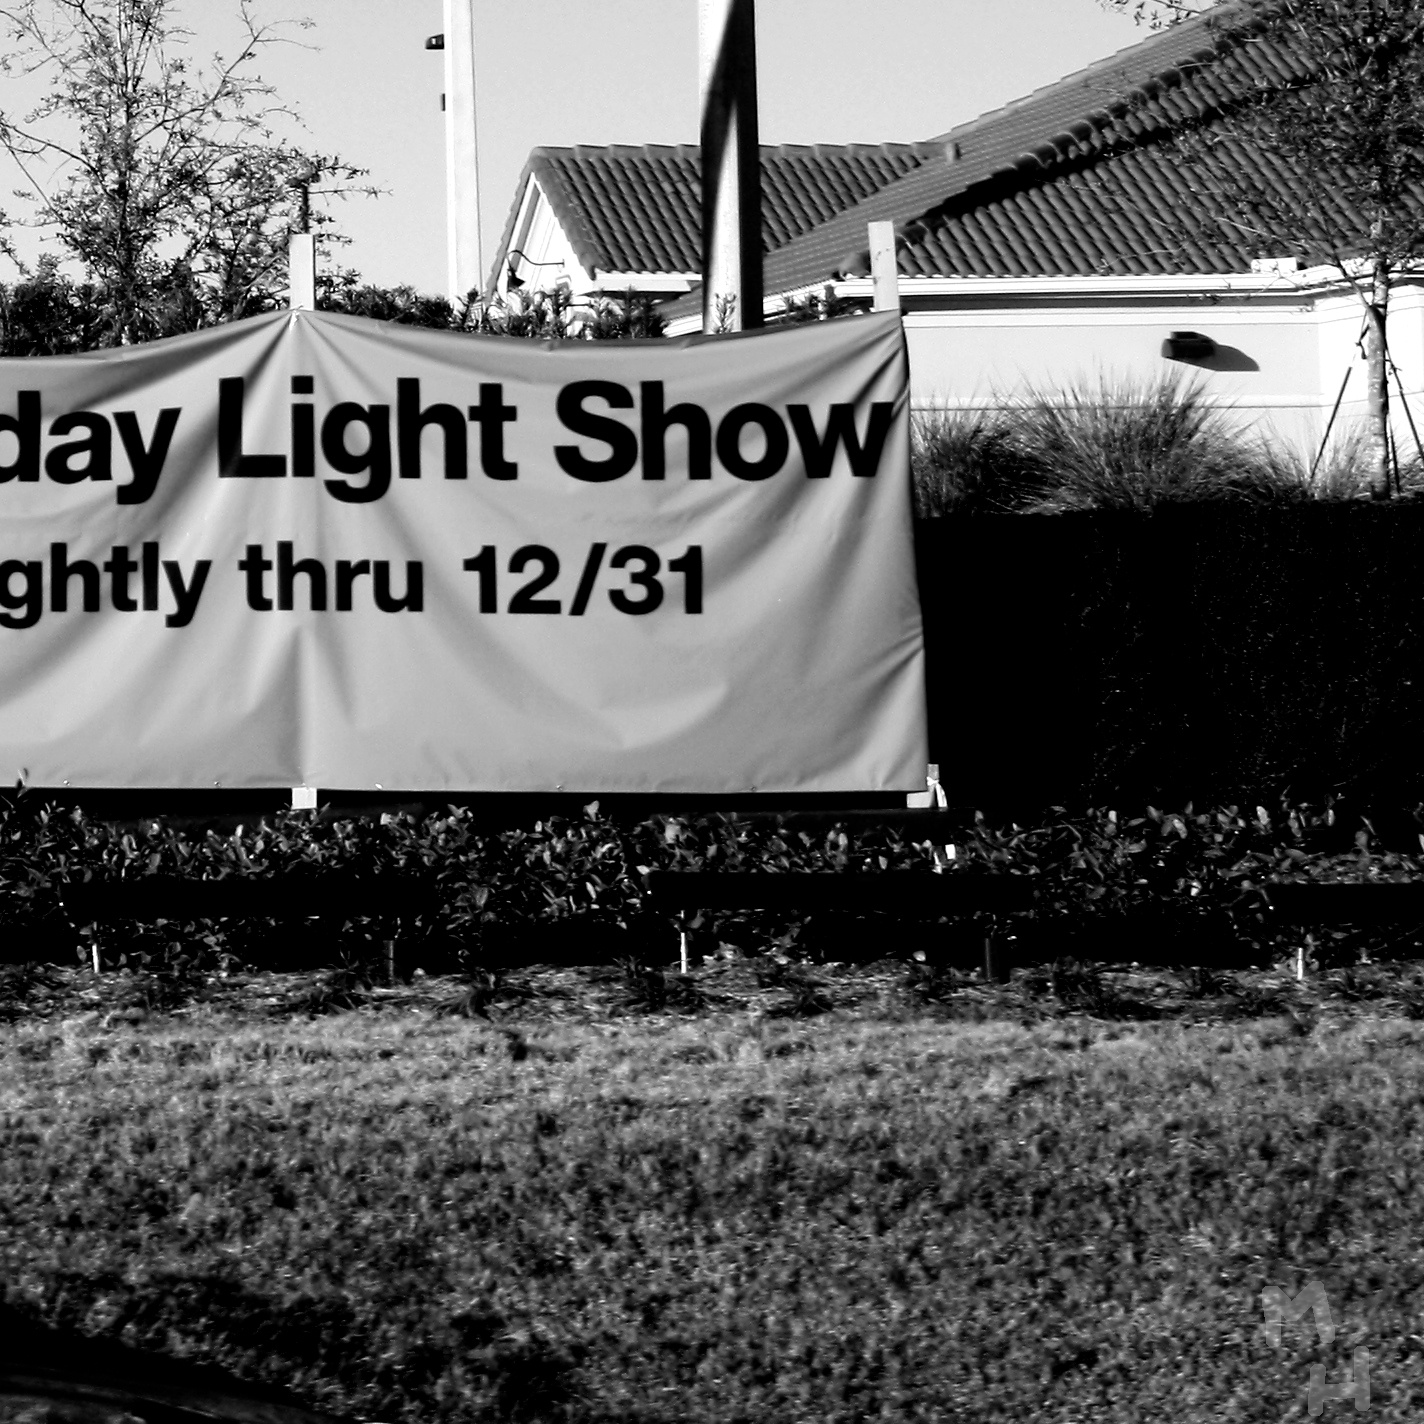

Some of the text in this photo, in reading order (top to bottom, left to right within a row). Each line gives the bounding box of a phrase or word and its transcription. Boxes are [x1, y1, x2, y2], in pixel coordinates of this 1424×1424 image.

[217, 375, 519, 504] Light
[554, 379, 896, 483] Show
[239, 540, 425, 613] thru
[463, 542, 704, 616] 12/31
